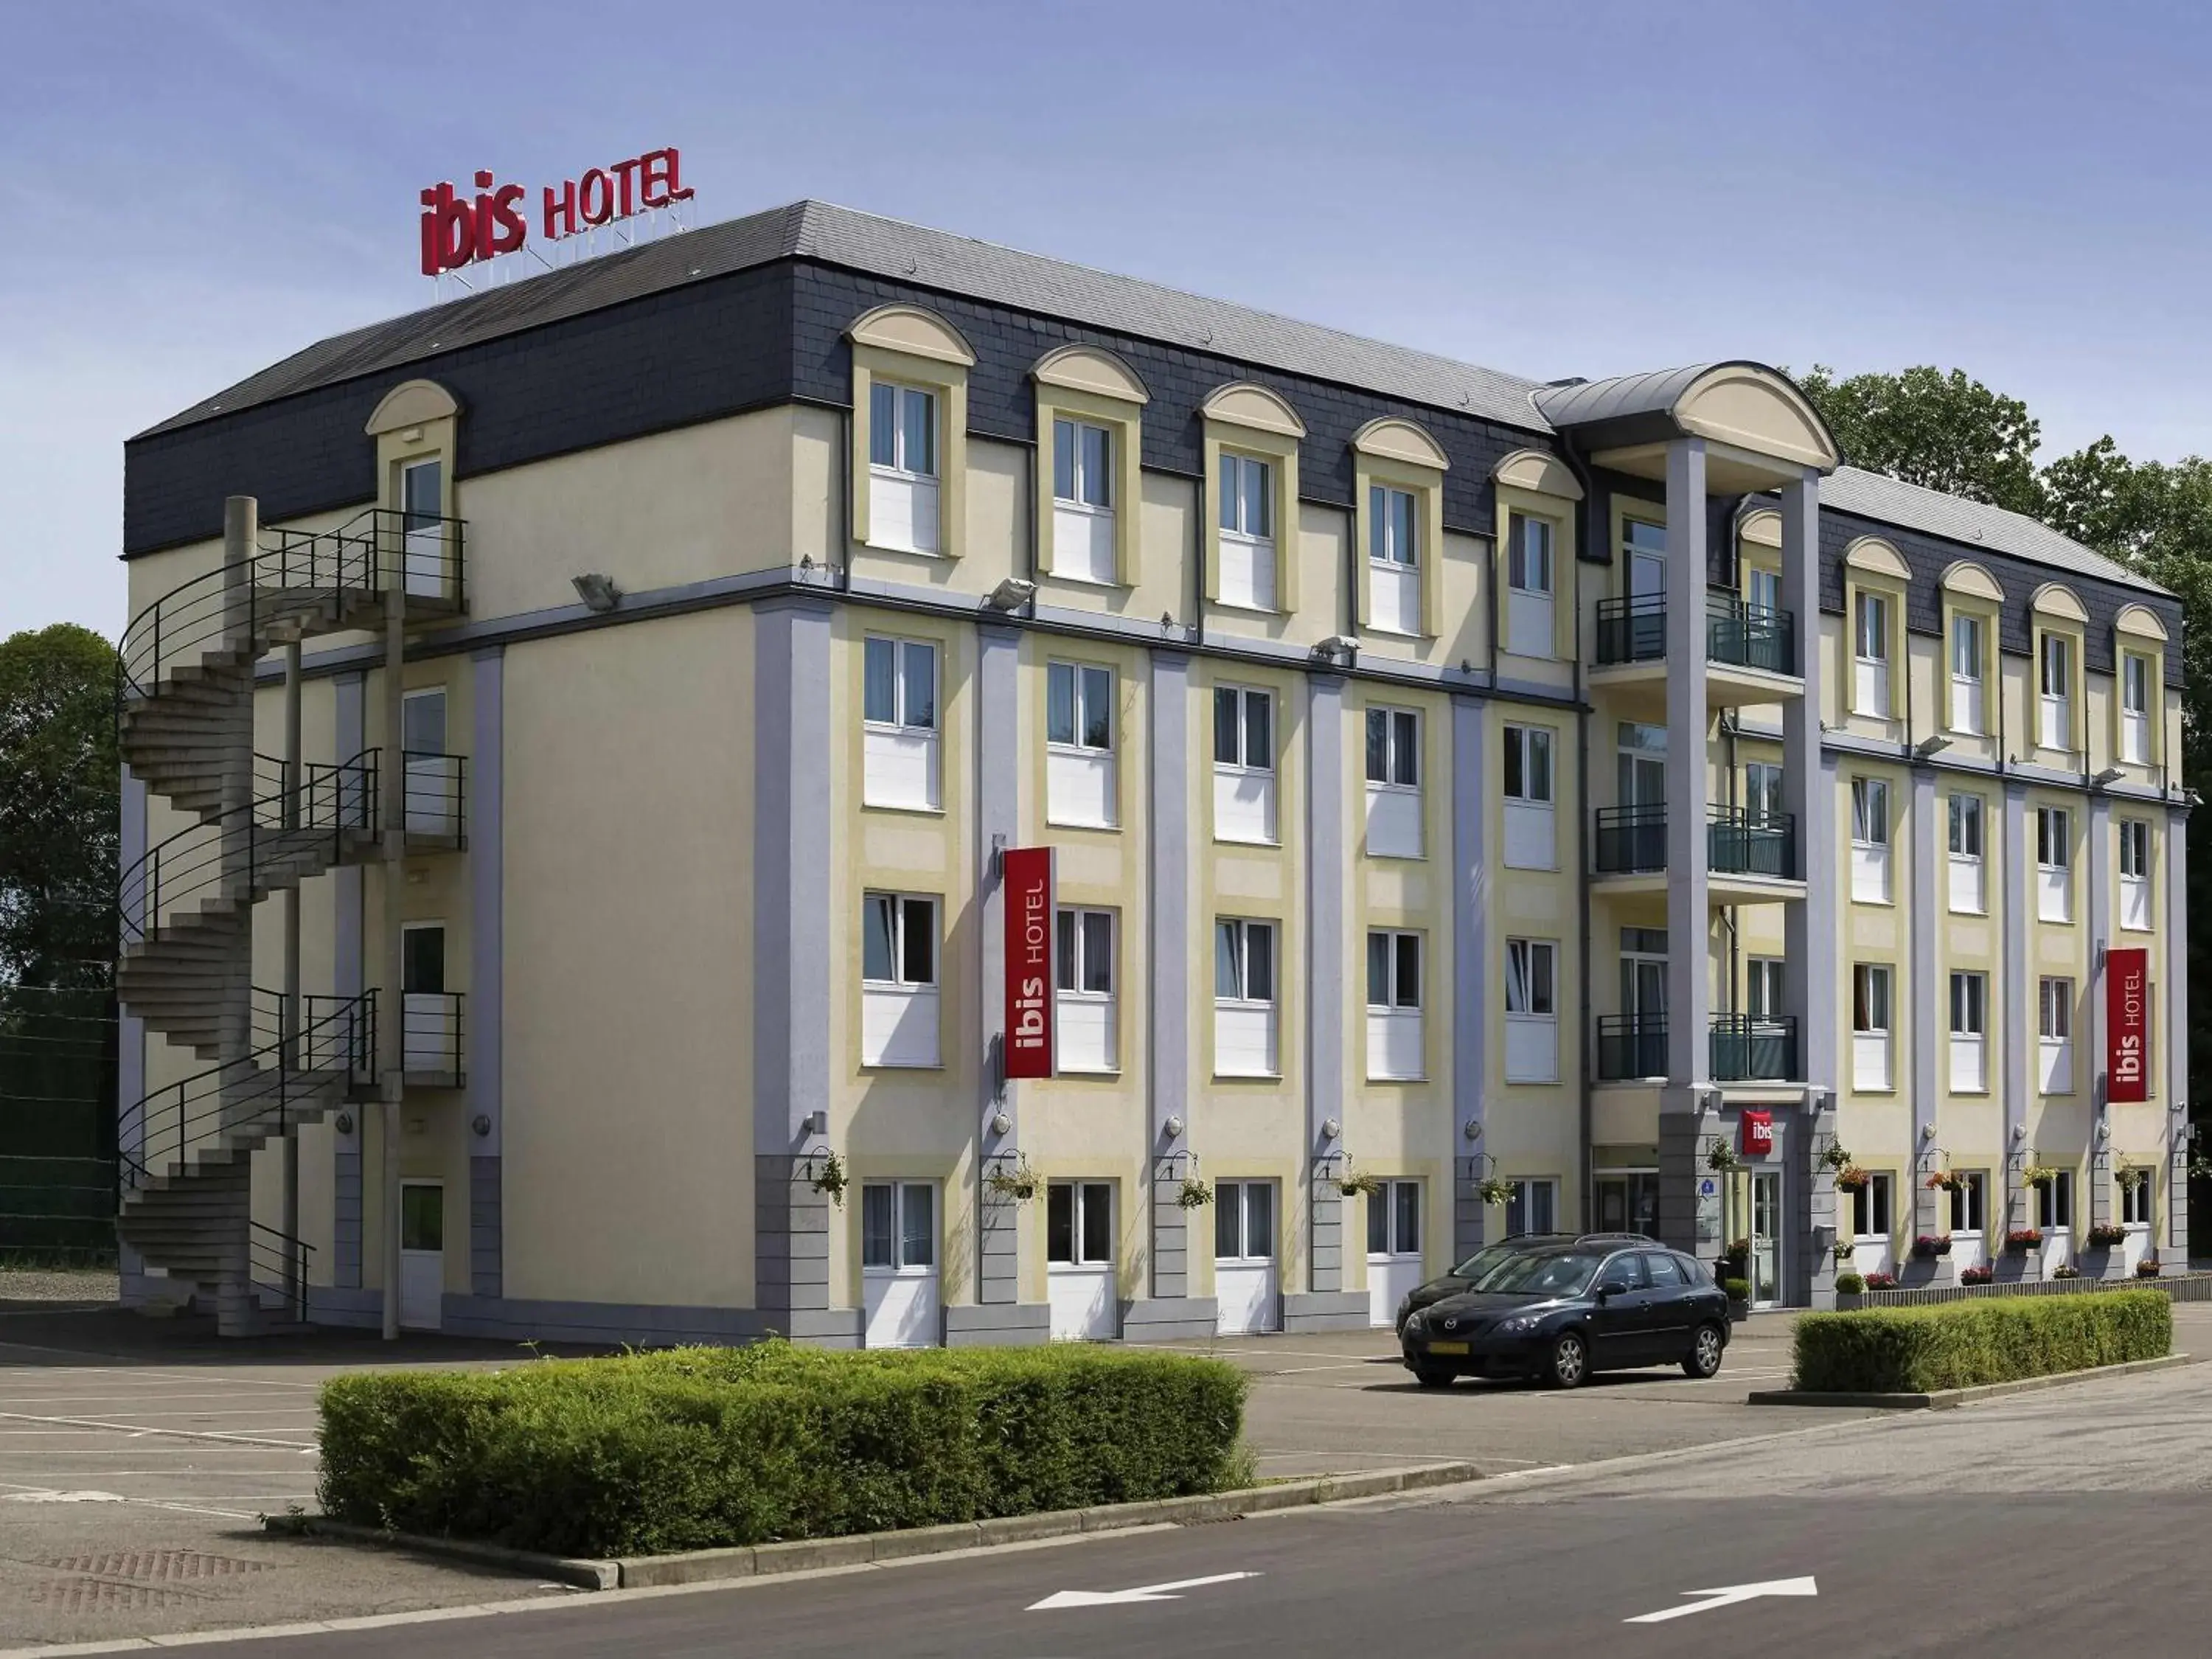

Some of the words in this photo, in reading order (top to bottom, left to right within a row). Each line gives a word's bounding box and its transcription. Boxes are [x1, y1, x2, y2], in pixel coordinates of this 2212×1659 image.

[420, 170, 526, 276] ibis
[543, 147, 695, 239] HOTEL
[1026, 879, 1043, 964] HOTEL
[1015, 977, 1043, 1048] ibis
[2126, 970, 2139, 1026] HOTEL
[2116, 1034, 2139, 1082] ibis
[1753, 1121, 1773, 1139] ibis
